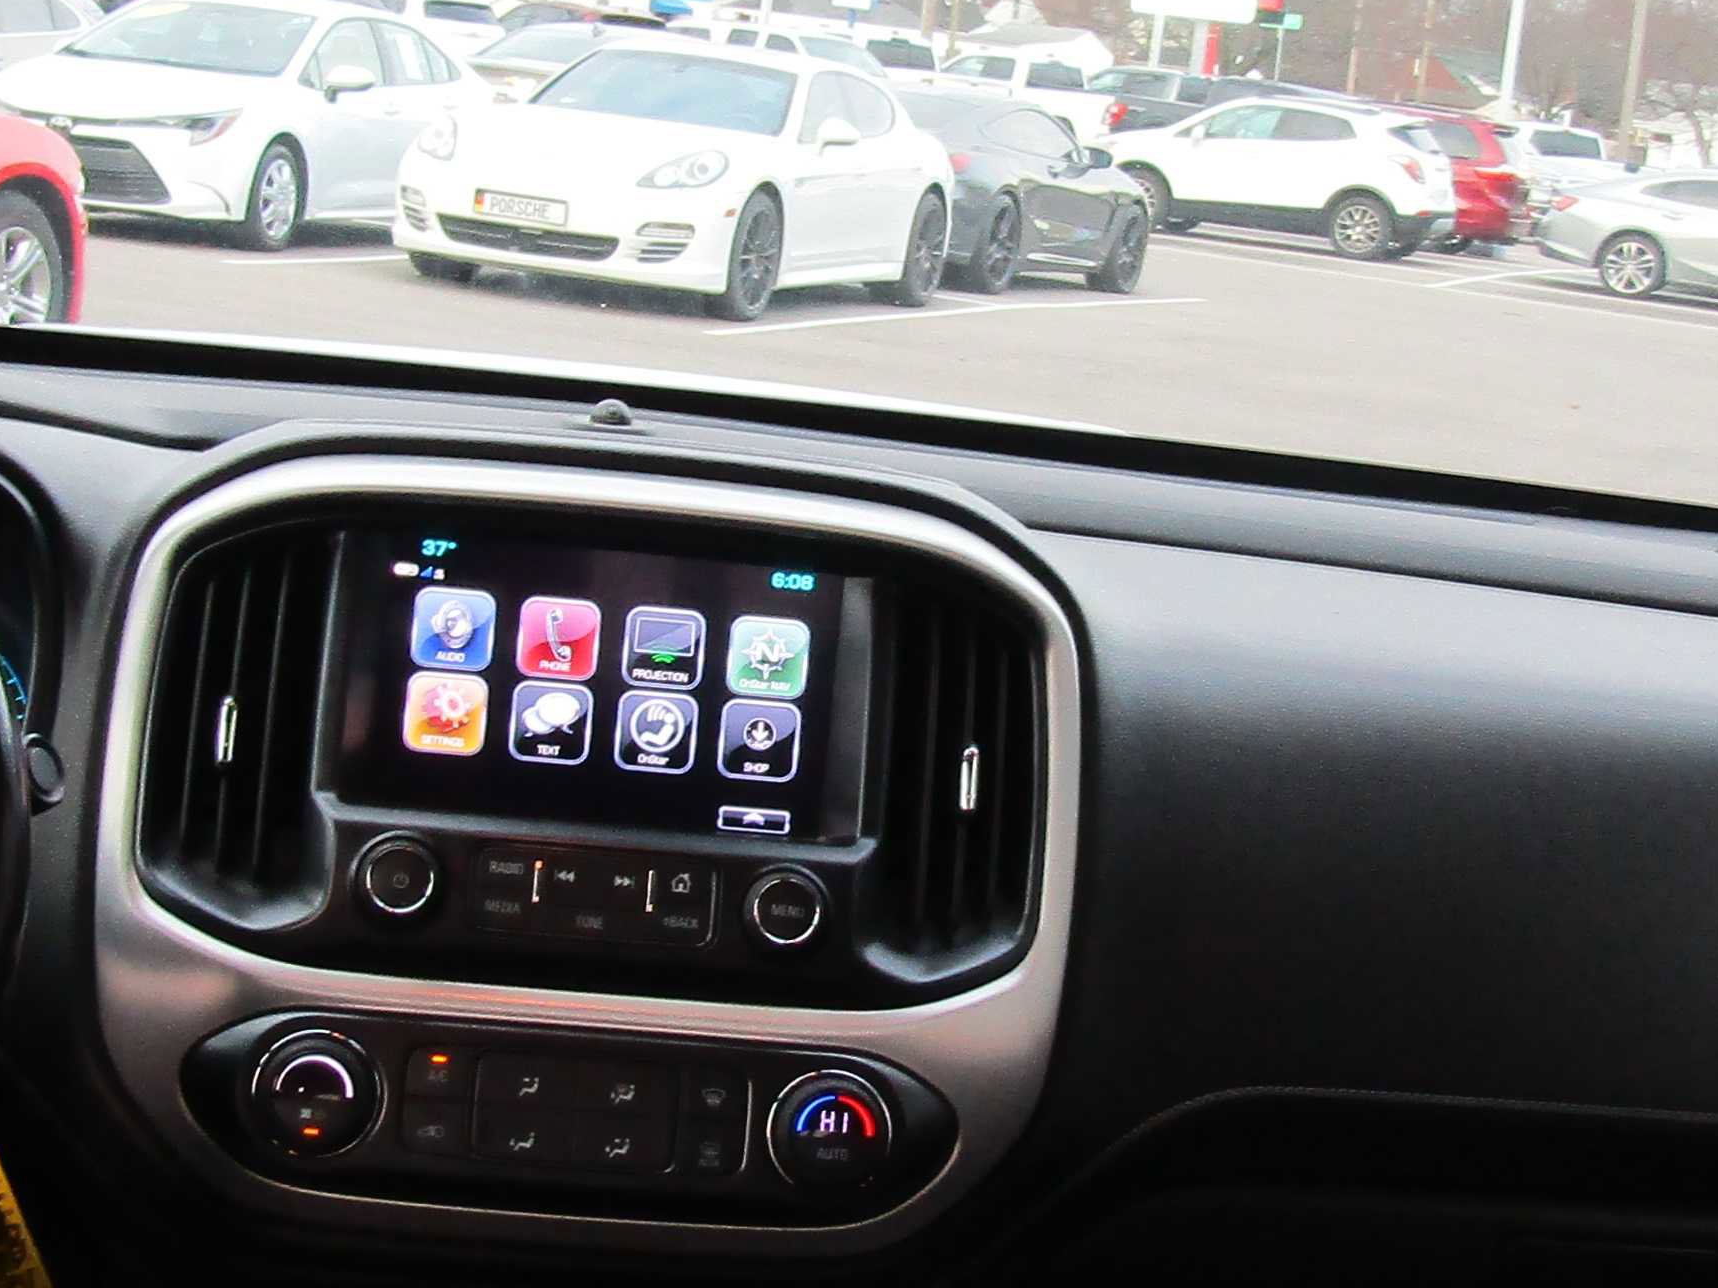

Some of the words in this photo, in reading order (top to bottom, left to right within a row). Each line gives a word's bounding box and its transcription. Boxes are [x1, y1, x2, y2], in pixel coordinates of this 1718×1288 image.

[490, 196, 550, 220] PORSCHE
[435, 651, 466, 663] AUDIO
[538, 660, 572, 672] PHONE
[631, 668, 689, 683] PROJECTION
[421, 734, 465, 748] SETTINGS
[536, 744, 561, 756] TEXT
[743, 761, 770, 774] SHOP
[489, 859, 524, 875] RADIO
[484, 899, 521, 915] MEDIA
[769, 902, 804, 919] MENU
[574, 914, 604, 930] TUNE
